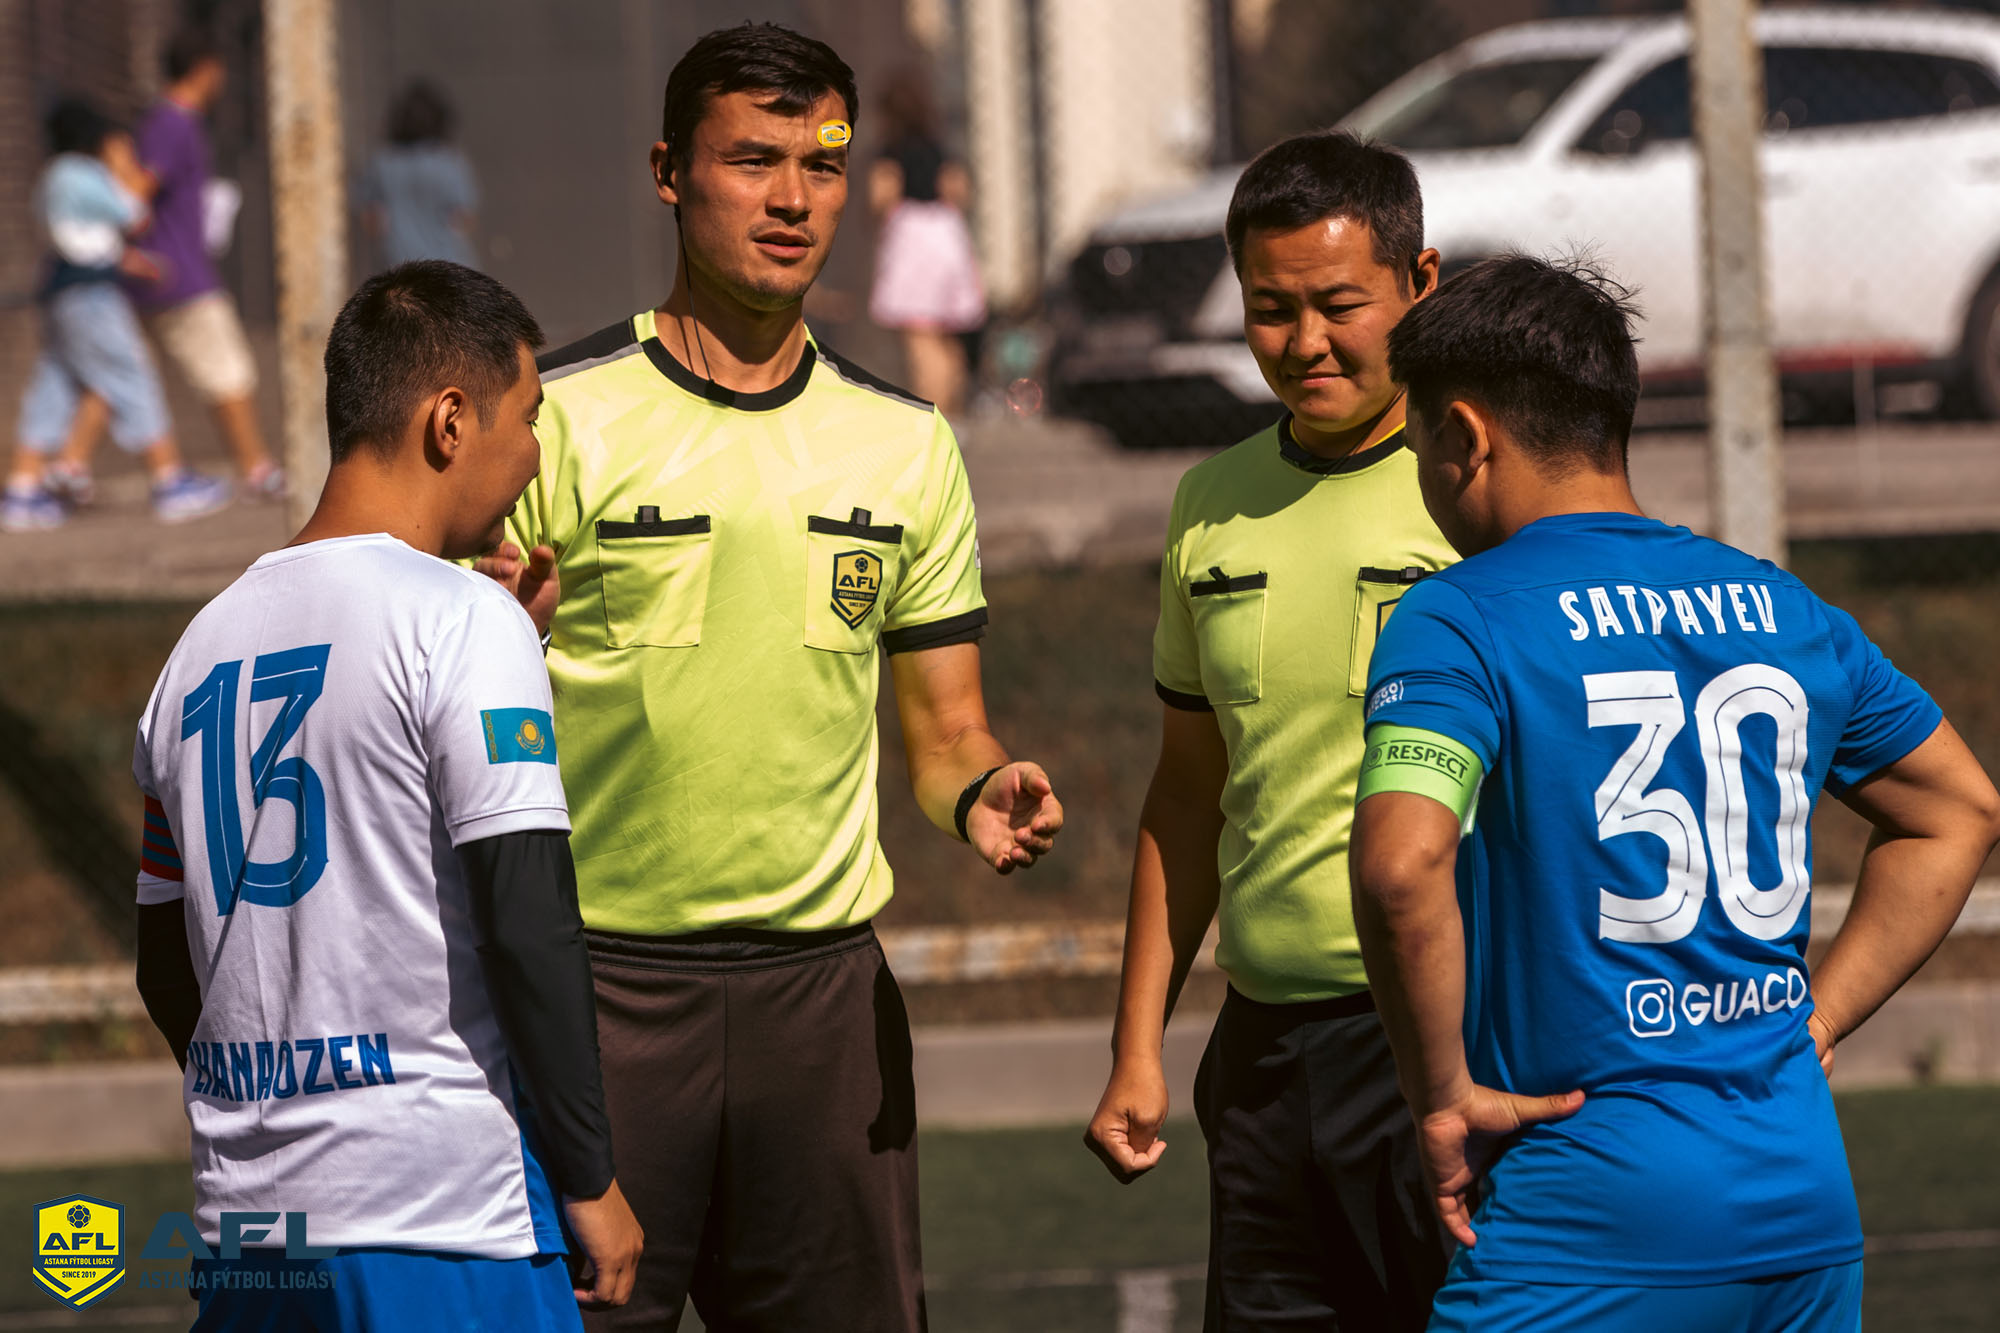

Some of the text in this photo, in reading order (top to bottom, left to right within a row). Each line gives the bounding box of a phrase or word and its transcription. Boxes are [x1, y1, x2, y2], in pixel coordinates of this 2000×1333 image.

[838, 574, 876, 590] AFL
[1558, 583, 1777, 641] SATPAYEV
[182, 644, 332, 916] 13
[1387, 745, 1468, 779] RESPECT
[1582, 663, 1810, 943] 30
